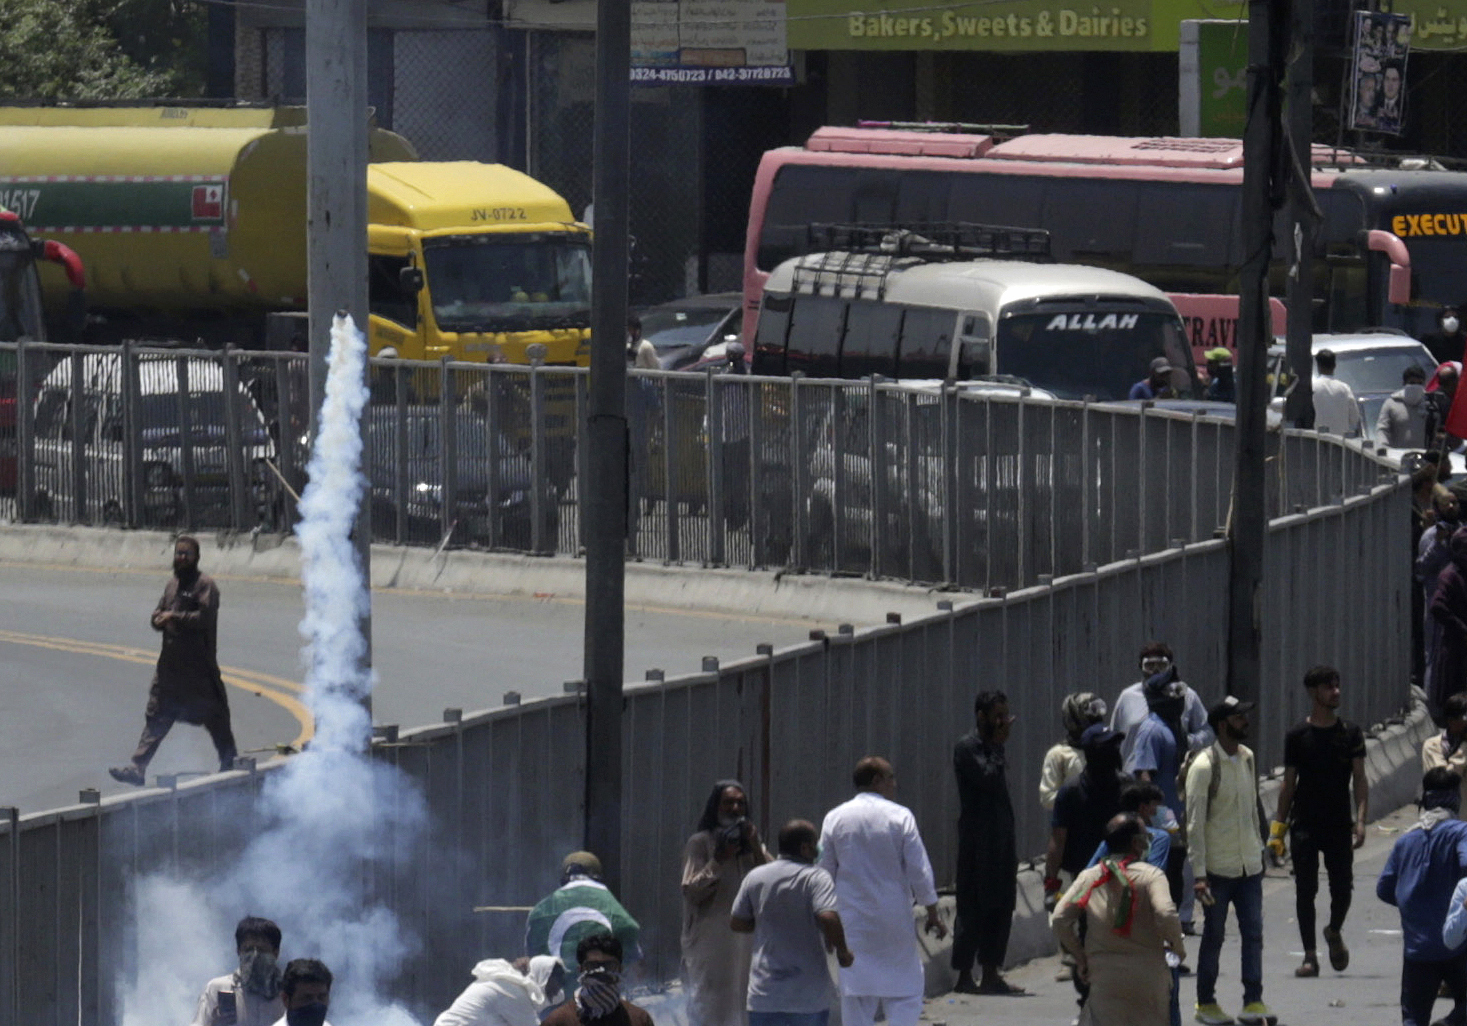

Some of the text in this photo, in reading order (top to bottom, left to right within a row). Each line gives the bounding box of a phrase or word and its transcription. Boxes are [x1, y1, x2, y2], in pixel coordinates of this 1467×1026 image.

[1036, 9, 1054, 37] &
[1059, 6, 1148, 37] Dairies
[470, 207, 527, 221] JV-0722
[1045, 313, 1139, 331] ALLAH
